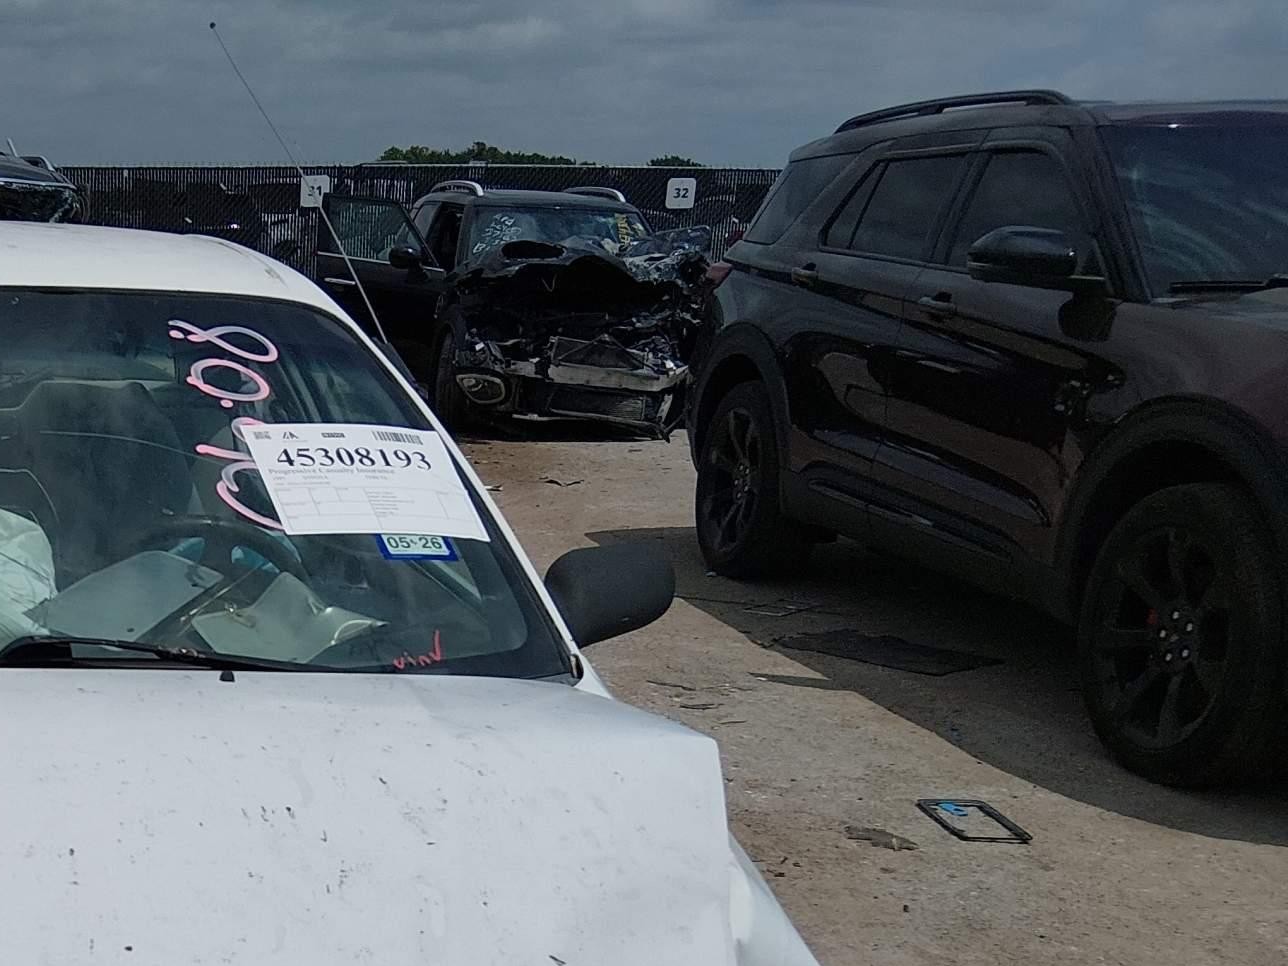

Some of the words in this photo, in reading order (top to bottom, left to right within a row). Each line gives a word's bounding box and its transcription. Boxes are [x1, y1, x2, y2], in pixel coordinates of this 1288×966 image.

[673, 188, 689, 198] 32
[276, 447, 432, 471] 45308193
[386, 536, 411, 549] 05
[418, 537, 443, 549] 26
